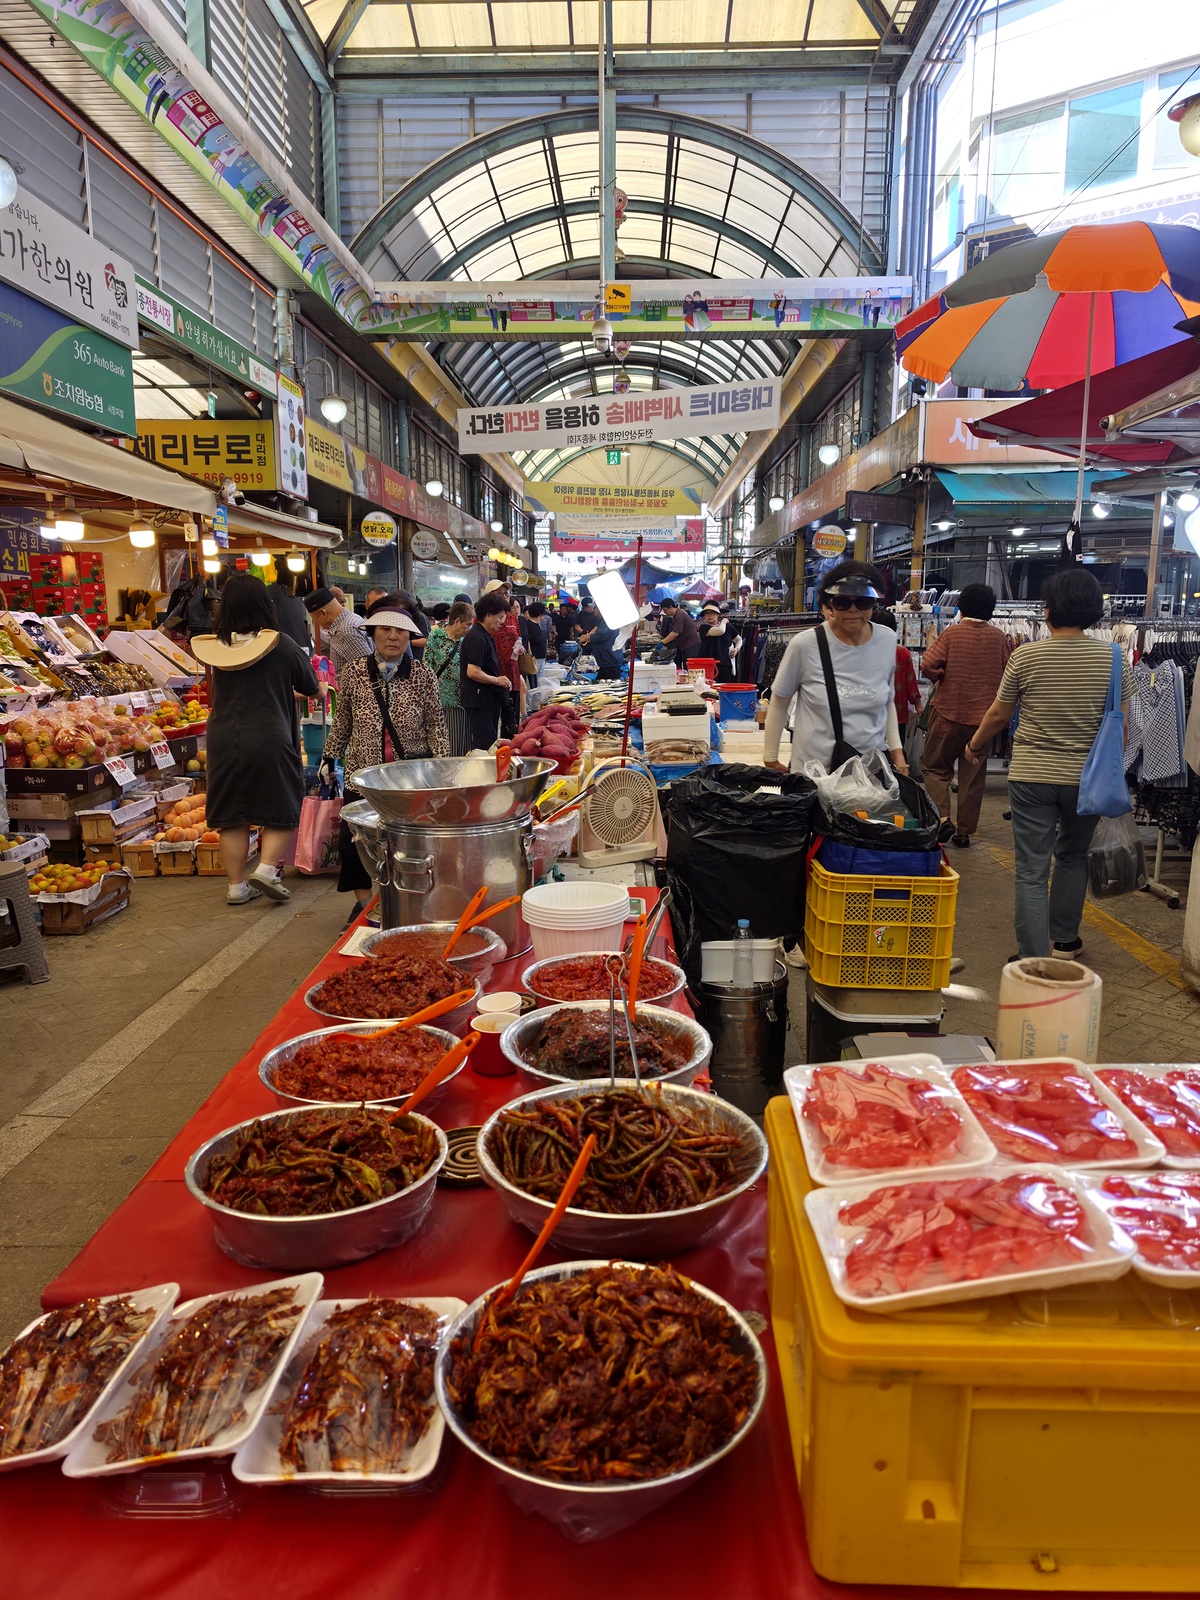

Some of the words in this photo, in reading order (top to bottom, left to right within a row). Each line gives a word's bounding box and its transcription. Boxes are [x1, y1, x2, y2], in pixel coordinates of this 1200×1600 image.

[0, 228, 94, 310] 가한의원
[0, 311, 23, 330] ngHyup
[73, 340, 92, 365] 365
[54, 377, 104, 414] 조치원농협
[132, 433, 253, 466] 체리부로
[255, 433, 267, 467] 대리점
[308, 432, 345, 469] 체리부로대리점
